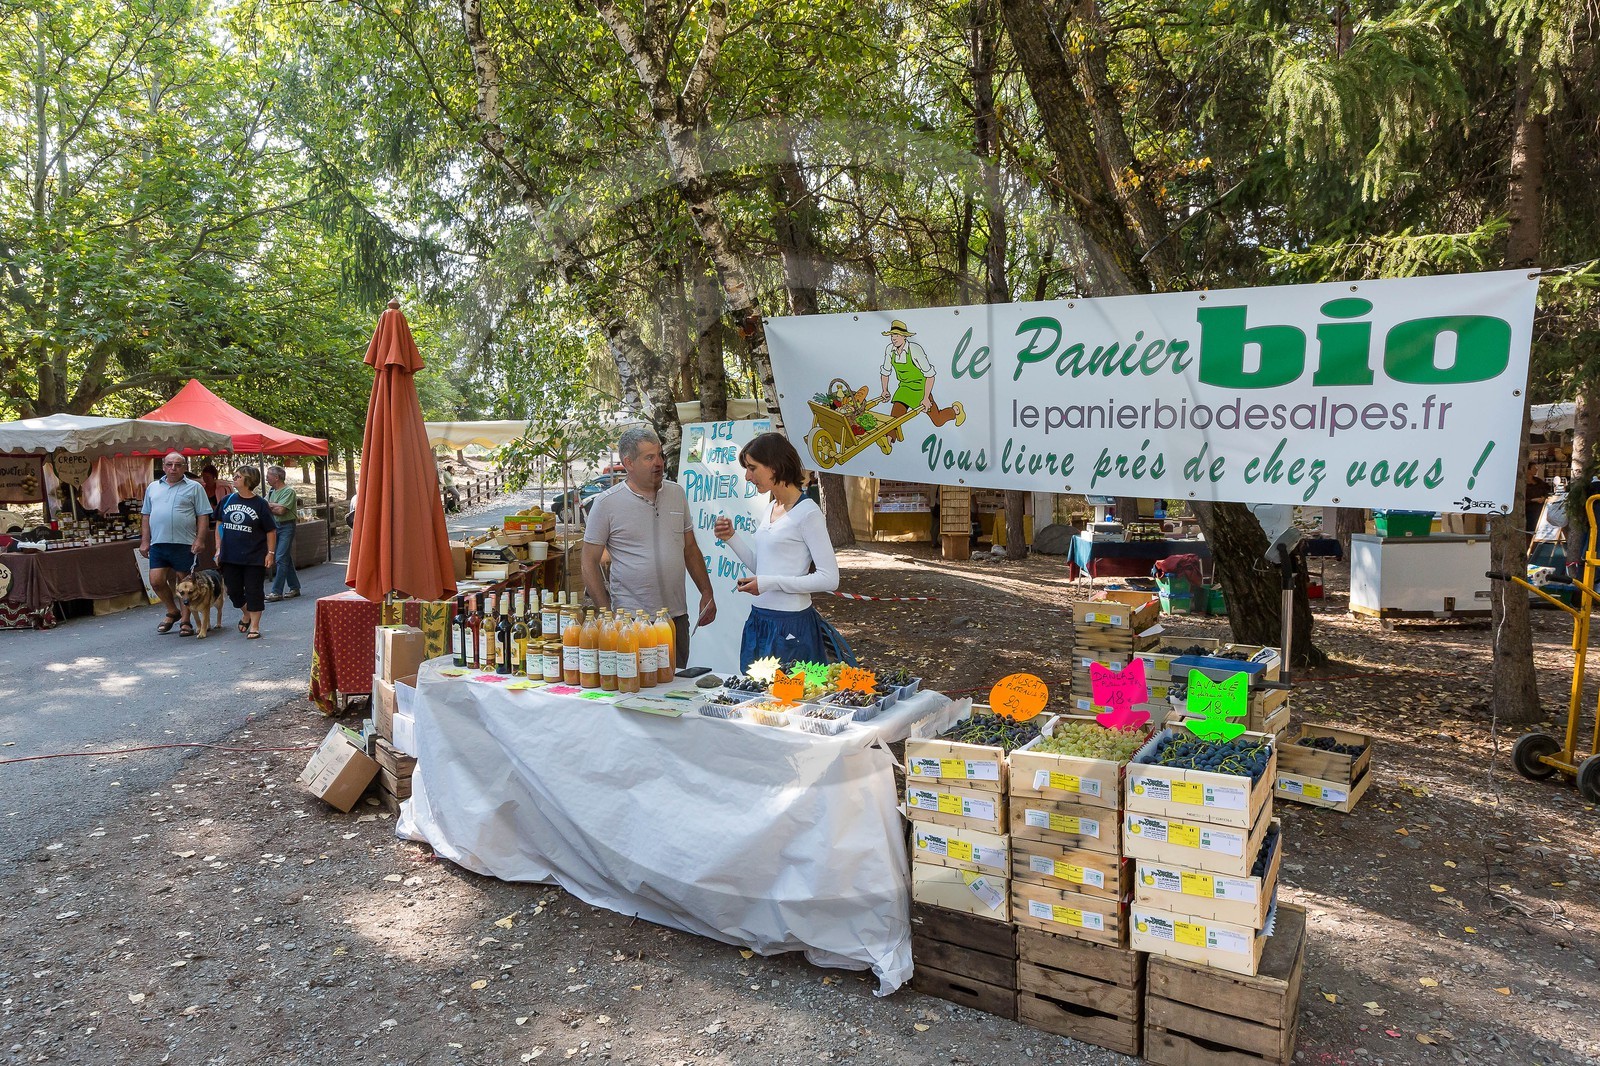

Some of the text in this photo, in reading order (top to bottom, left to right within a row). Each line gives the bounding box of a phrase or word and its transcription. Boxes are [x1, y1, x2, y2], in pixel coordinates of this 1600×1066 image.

[951, 297, 1512, 389] le Panier bio
[1012, 394, 1453, 437] lepanierbiodesalpes.fr
[711, 421, 735, 440] ICI
[706, 446, 737, 465] VOTRE
[921, 433, 1496, 502] Vous livre prés de chez vous !
[223, 522, 252, 533] FIRENZE
[1011, 674, 1045, 690] MUSCAT
[1092, 671, 1135, 681] DANLAS
[1003, 695, 1020, 710] 20
[1106, 690, 1125, 705] 18
[1200, 700, 1222, 715] 18
